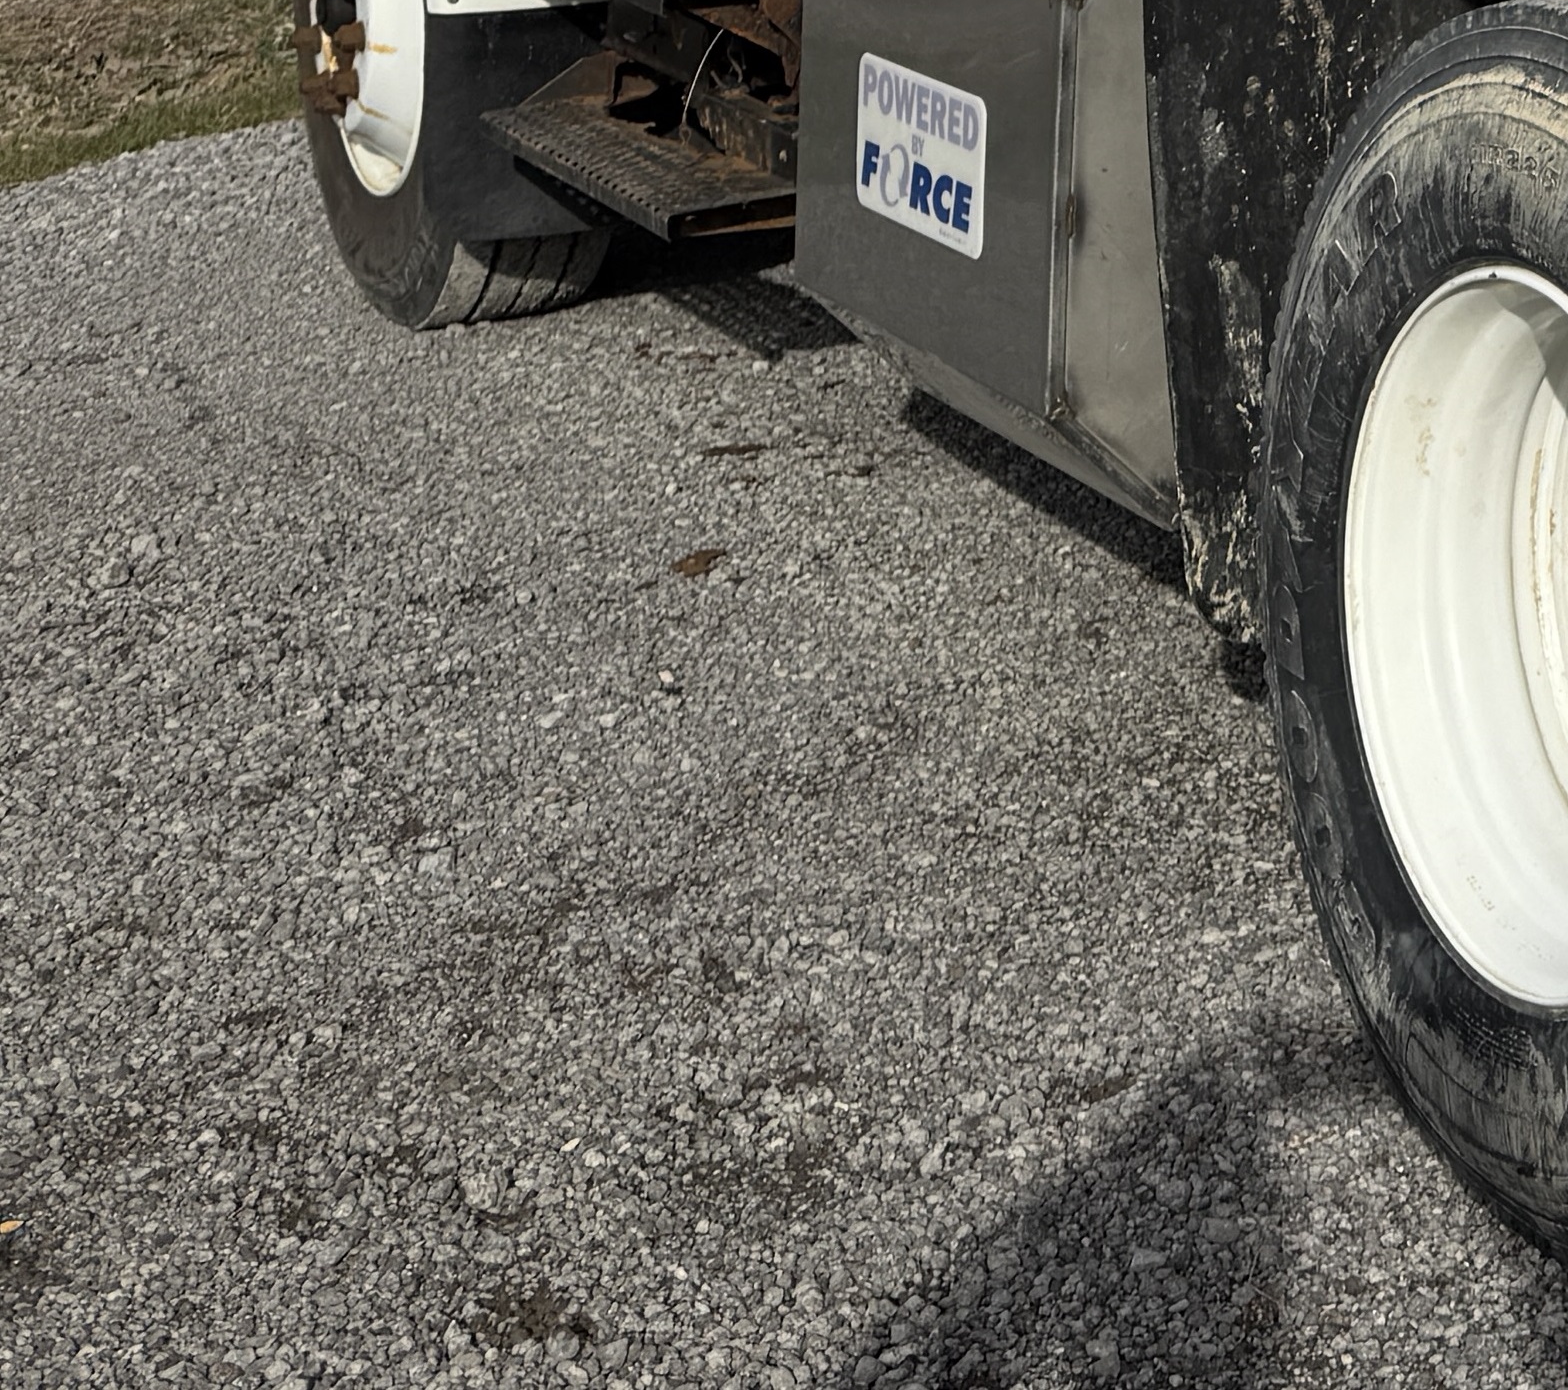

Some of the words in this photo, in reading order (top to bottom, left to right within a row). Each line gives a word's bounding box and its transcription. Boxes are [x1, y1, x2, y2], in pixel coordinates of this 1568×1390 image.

[863, 64, 979, 151] POWERED
[912, 135, 924, 157] BY
[861, 140, 972, 233] FORCE
